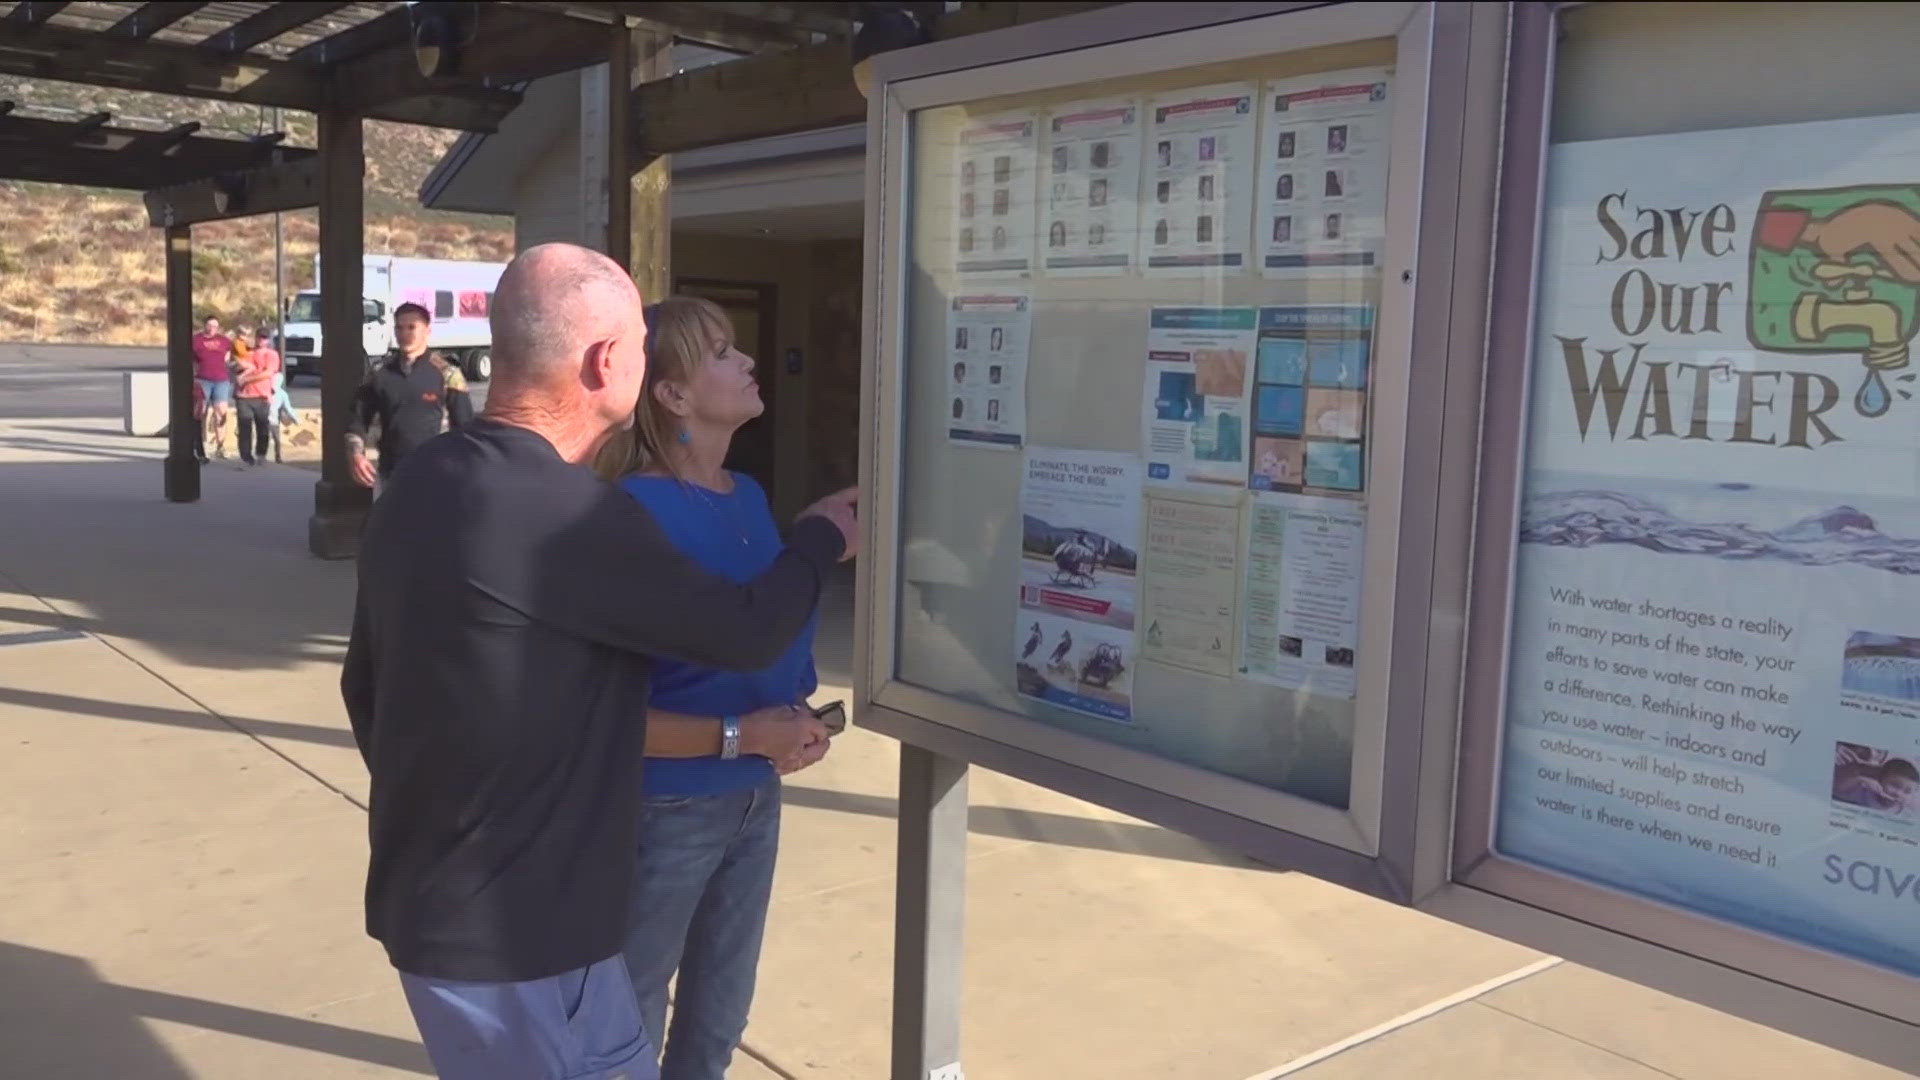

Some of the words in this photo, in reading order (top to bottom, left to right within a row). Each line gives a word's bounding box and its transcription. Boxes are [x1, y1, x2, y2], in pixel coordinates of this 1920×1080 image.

[1596, 189, 1736, 264] Save
[1611, 269, 1733, 336] Our
[1553, 334, 1846, 450] WATER
[1029, 459, 1068, 472] ELIMINATE
[1072, 463, 1089, 473] THE
[1029, 470, 1065, 482] EMBRACE
[1068, 475, 1084, 484] THE
[1549, 587, 1586, 607] With
[1589, 597, 1633, 614] water
[1638, 599, 1716, 630] shortages
[1722, 616, 1732, 629] a
[1738, 614, 1793, 641] reality
[1548, 618, 1561, 632] in
[1565, 623, 1607, 644] many
[1611, 630, 1650, 651] parts
[1655, 636, 1672, 651] of
[1676, 638, 1700, 656] the
[1705, 643, 1748, 666] state,
[1755, 653, 1795, 672] your
[1545, 646, 1589, 669] efforts
[1594, 656, 1608, 672] to
[1612, 664, 1648, 680] save
[1653, 669, 1698, 687] water
[1704, 678, 1735, 695] can
[1741, 681, 1789, 705] make
[1541, 710, 1569, 727] you
[1573, 716, 1598, 731] use
[1602, 720, 1645, 741] water
[1665, 731, 1727, 759] indoors
[1732, 745, 1766, 767] and
[1543, 680, 1554, 692] a
[1558, 678, 1636, 708] difference.
[1642, 694, 1725, 730] Rethinking
[1730, 710, 1756, 731] the
[1762, 722, 1801, 744] way
[1539, 737, 1603, 763] outdoors
[1621, 755, 1648, 772] will
[1652, 758, 1687, 783] help
[1692, 771, 1745, 795] stretch
[1536, 794, 1577, 816] water
[1581, 804, 1593, 820] is
[1597, 807, 1634, 832] there
[1639, 820, 1682, 843] when
[1687, 833, 1712, 852] we
[1718, 839, 1762, 865] need
[1537, 766, 1562, 781] our
[1566, 767, 1615, 795] limited
[1619, 781, 1681, 813] supplies
[1686, 800, 1720, 821] and
[1725, 812, 1782, 836] ensure
[1823, 853, 1920, 904] sav
